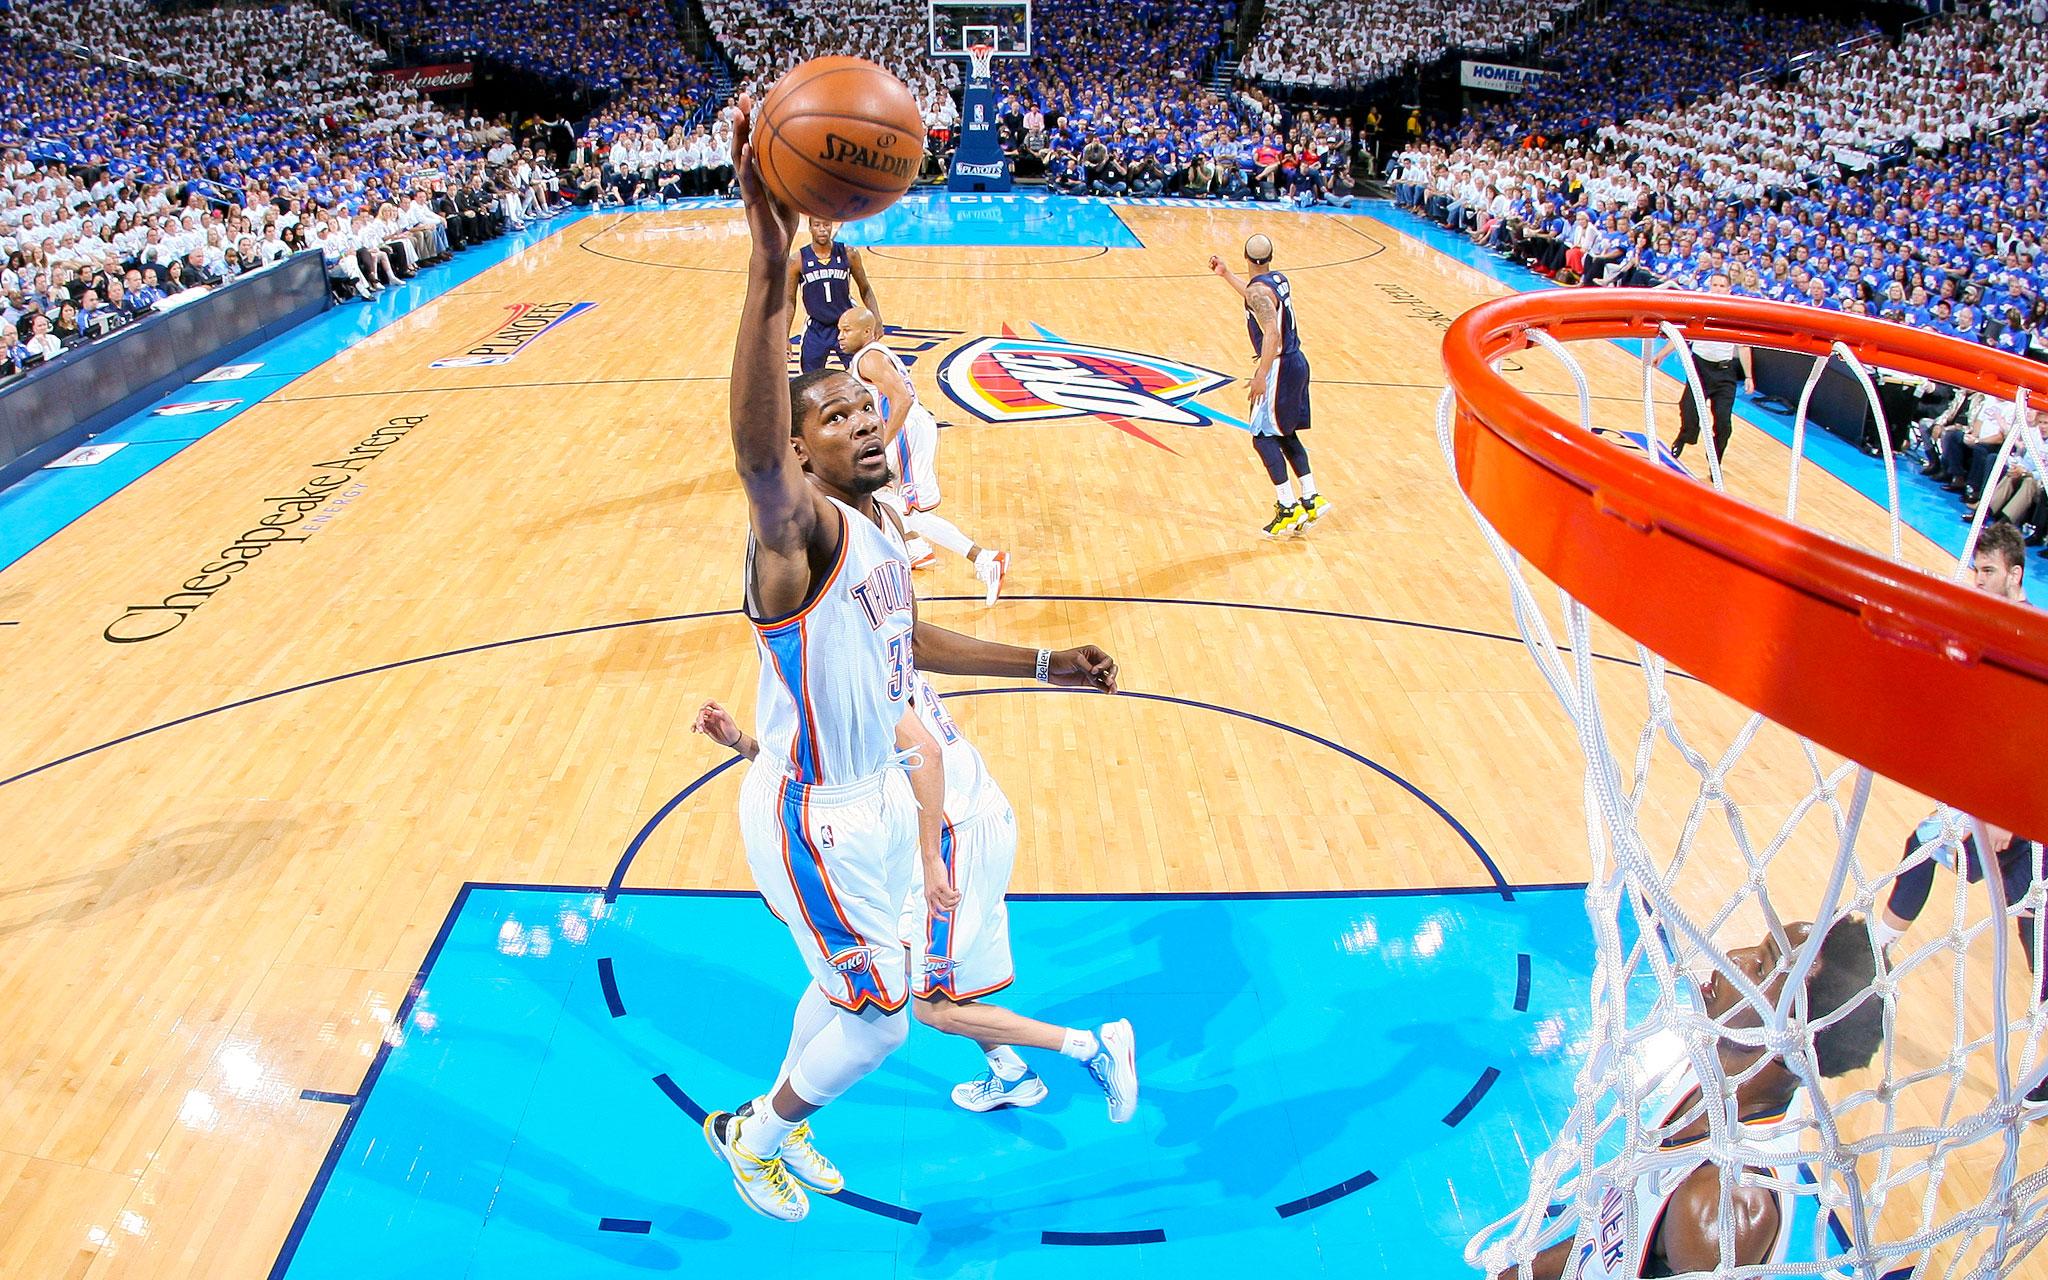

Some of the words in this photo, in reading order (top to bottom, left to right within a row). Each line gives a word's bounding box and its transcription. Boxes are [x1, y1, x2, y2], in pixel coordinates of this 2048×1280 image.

[1473, 65, 1546, 84] HOMELAN
[951, 195, 1047, 204] CITY
[805, 268, 847, 283] MEMPHIS
[823, 281, 832, 303] 1
[467, 302, 573, 355] PLAYOFFS
[302, 482, 369, 532] ENERGY
[103, 474, 351, 643] Chesapeake
[312, 414, 429, 472] Arena
